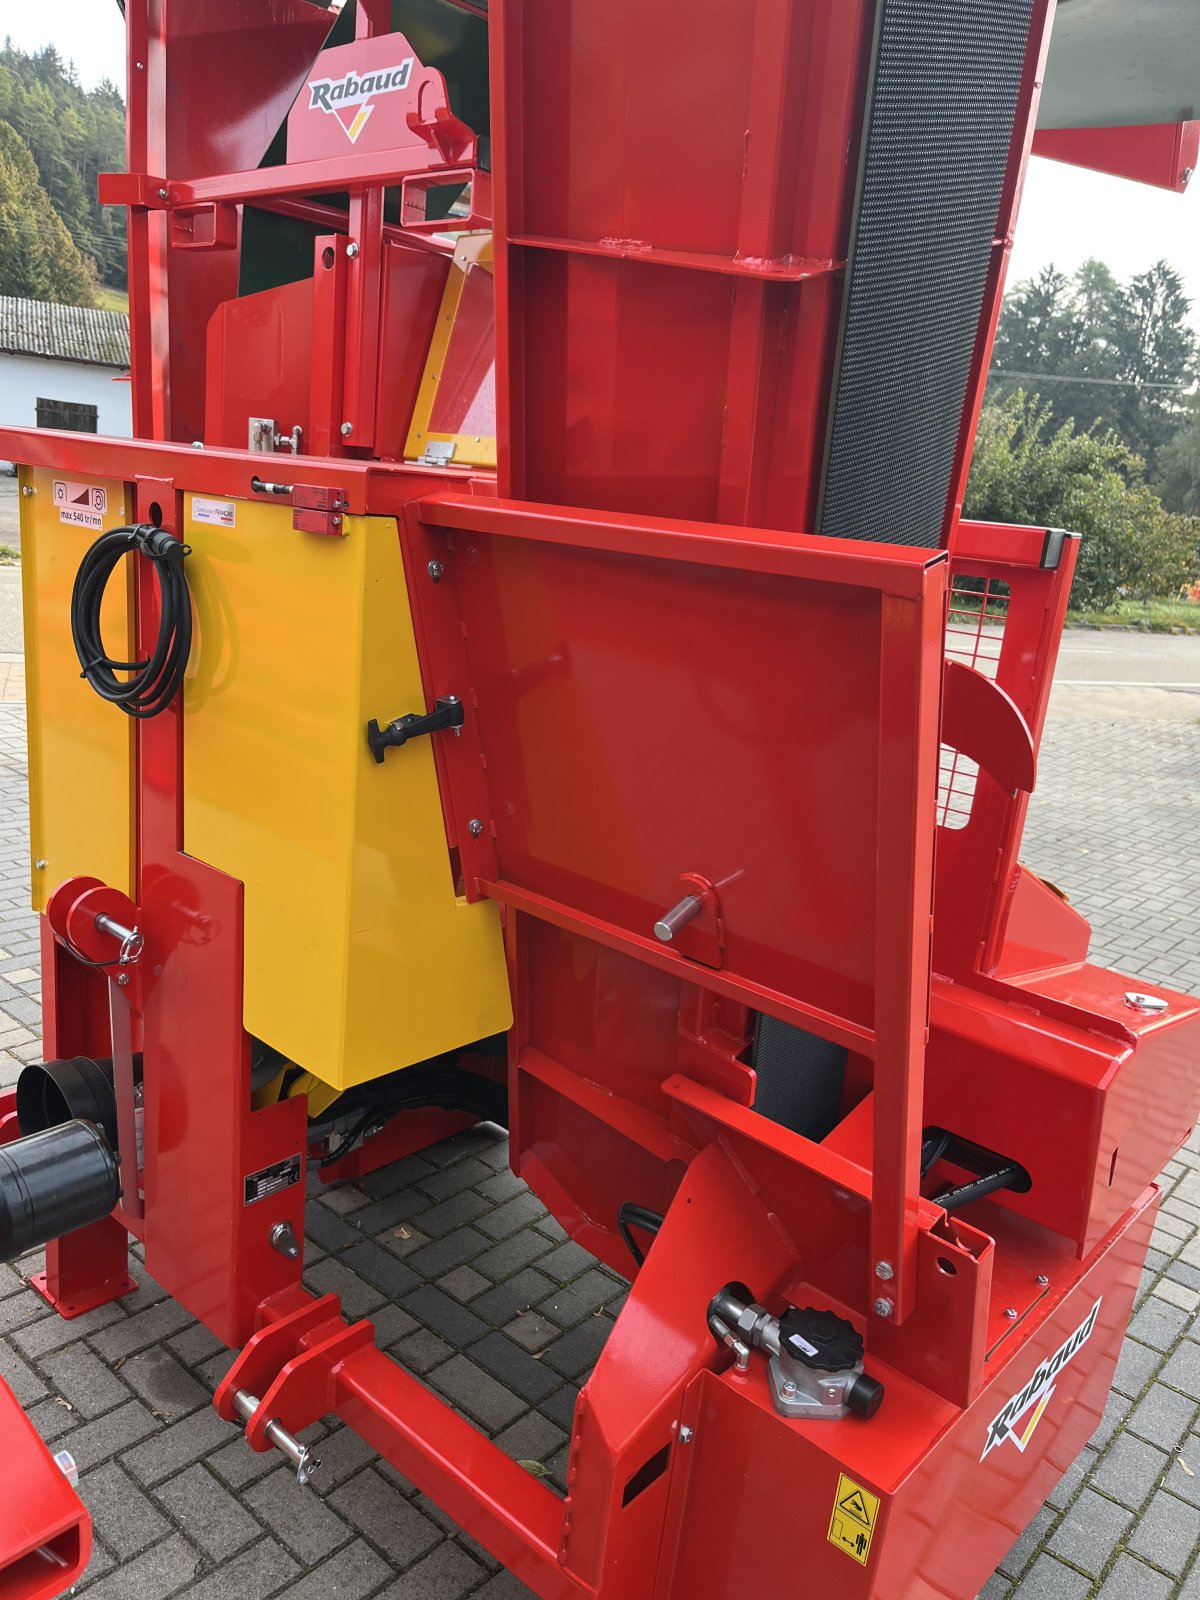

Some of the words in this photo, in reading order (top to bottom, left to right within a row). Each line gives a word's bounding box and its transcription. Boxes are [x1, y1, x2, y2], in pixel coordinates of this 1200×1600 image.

[311, 63, 410, 111] Rabaud
[61, 511, 72, 520] max
[73, 512, 84, 522] 540
[85, 514, 102, 526] tr/mn
[984, 1303, 1098, 1453] Rabaud
